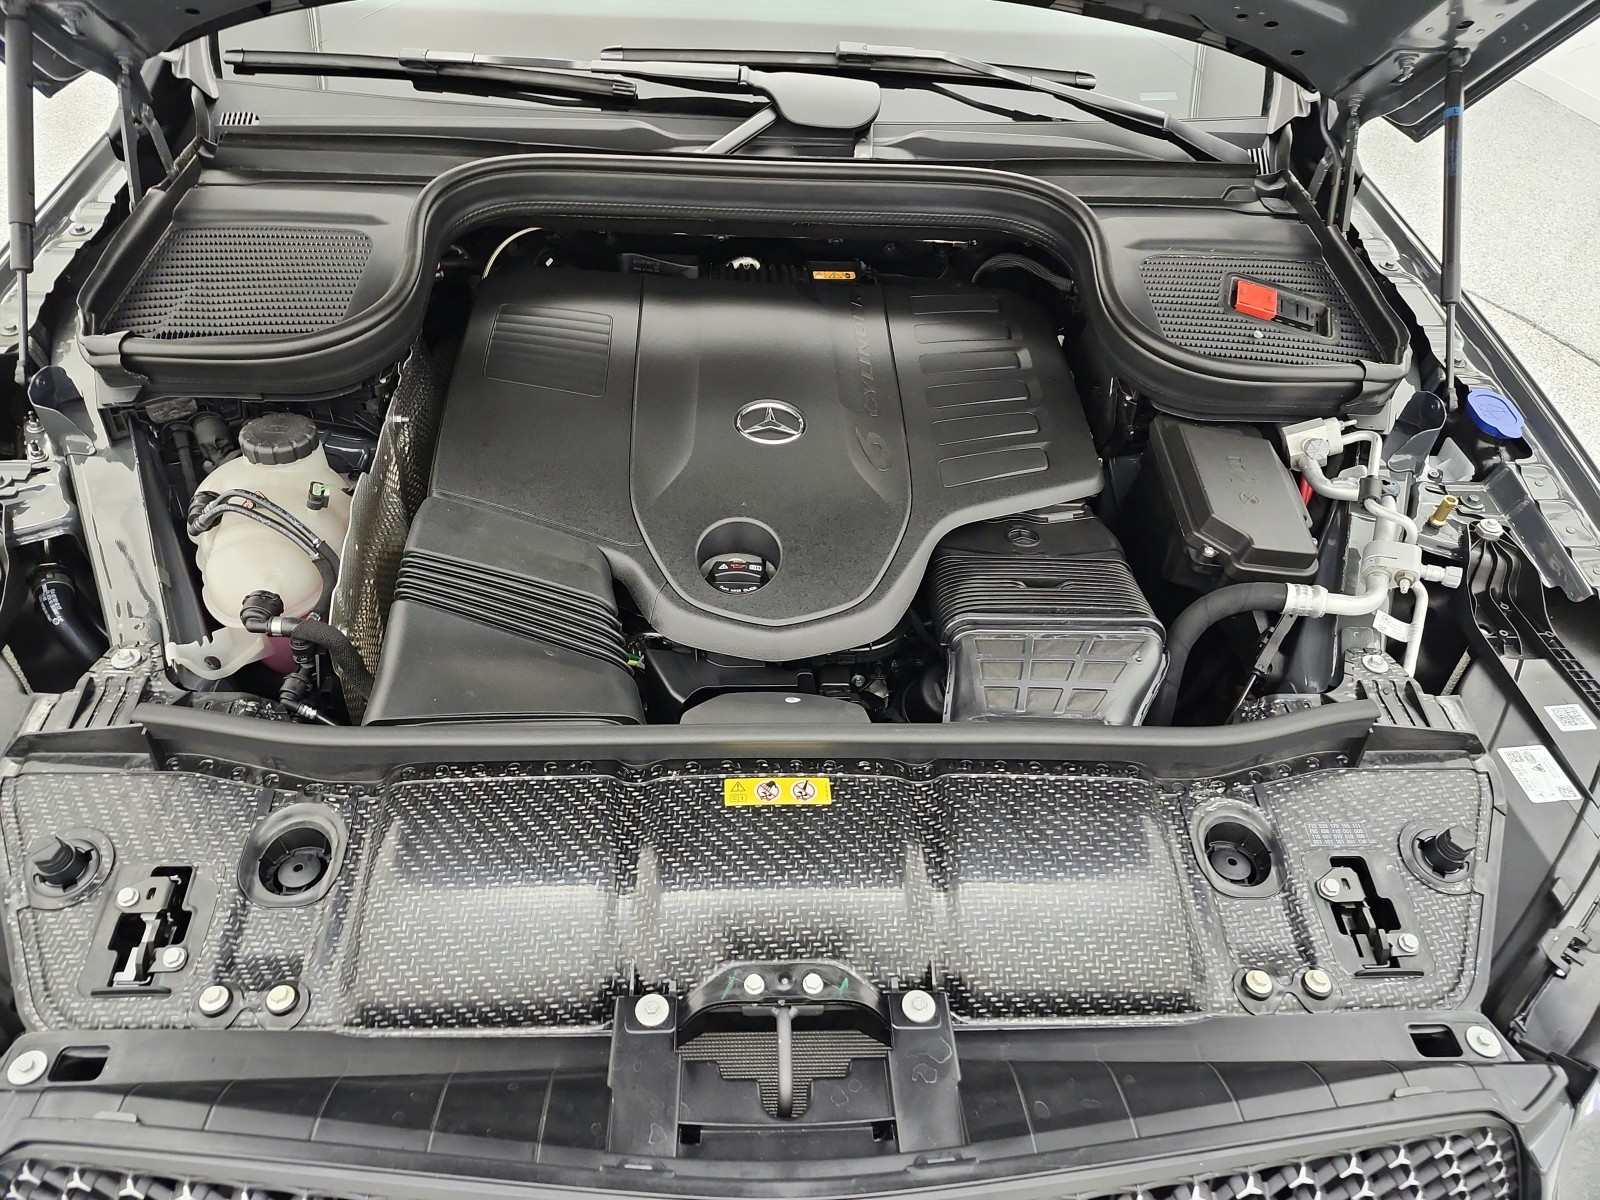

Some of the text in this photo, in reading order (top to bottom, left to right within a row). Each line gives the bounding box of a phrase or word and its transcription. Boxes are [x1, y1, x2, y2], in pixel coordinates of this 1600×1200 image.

[850, 295, 892, 472] 6 CYLIND
[302, 705, 317, 716] TOP
